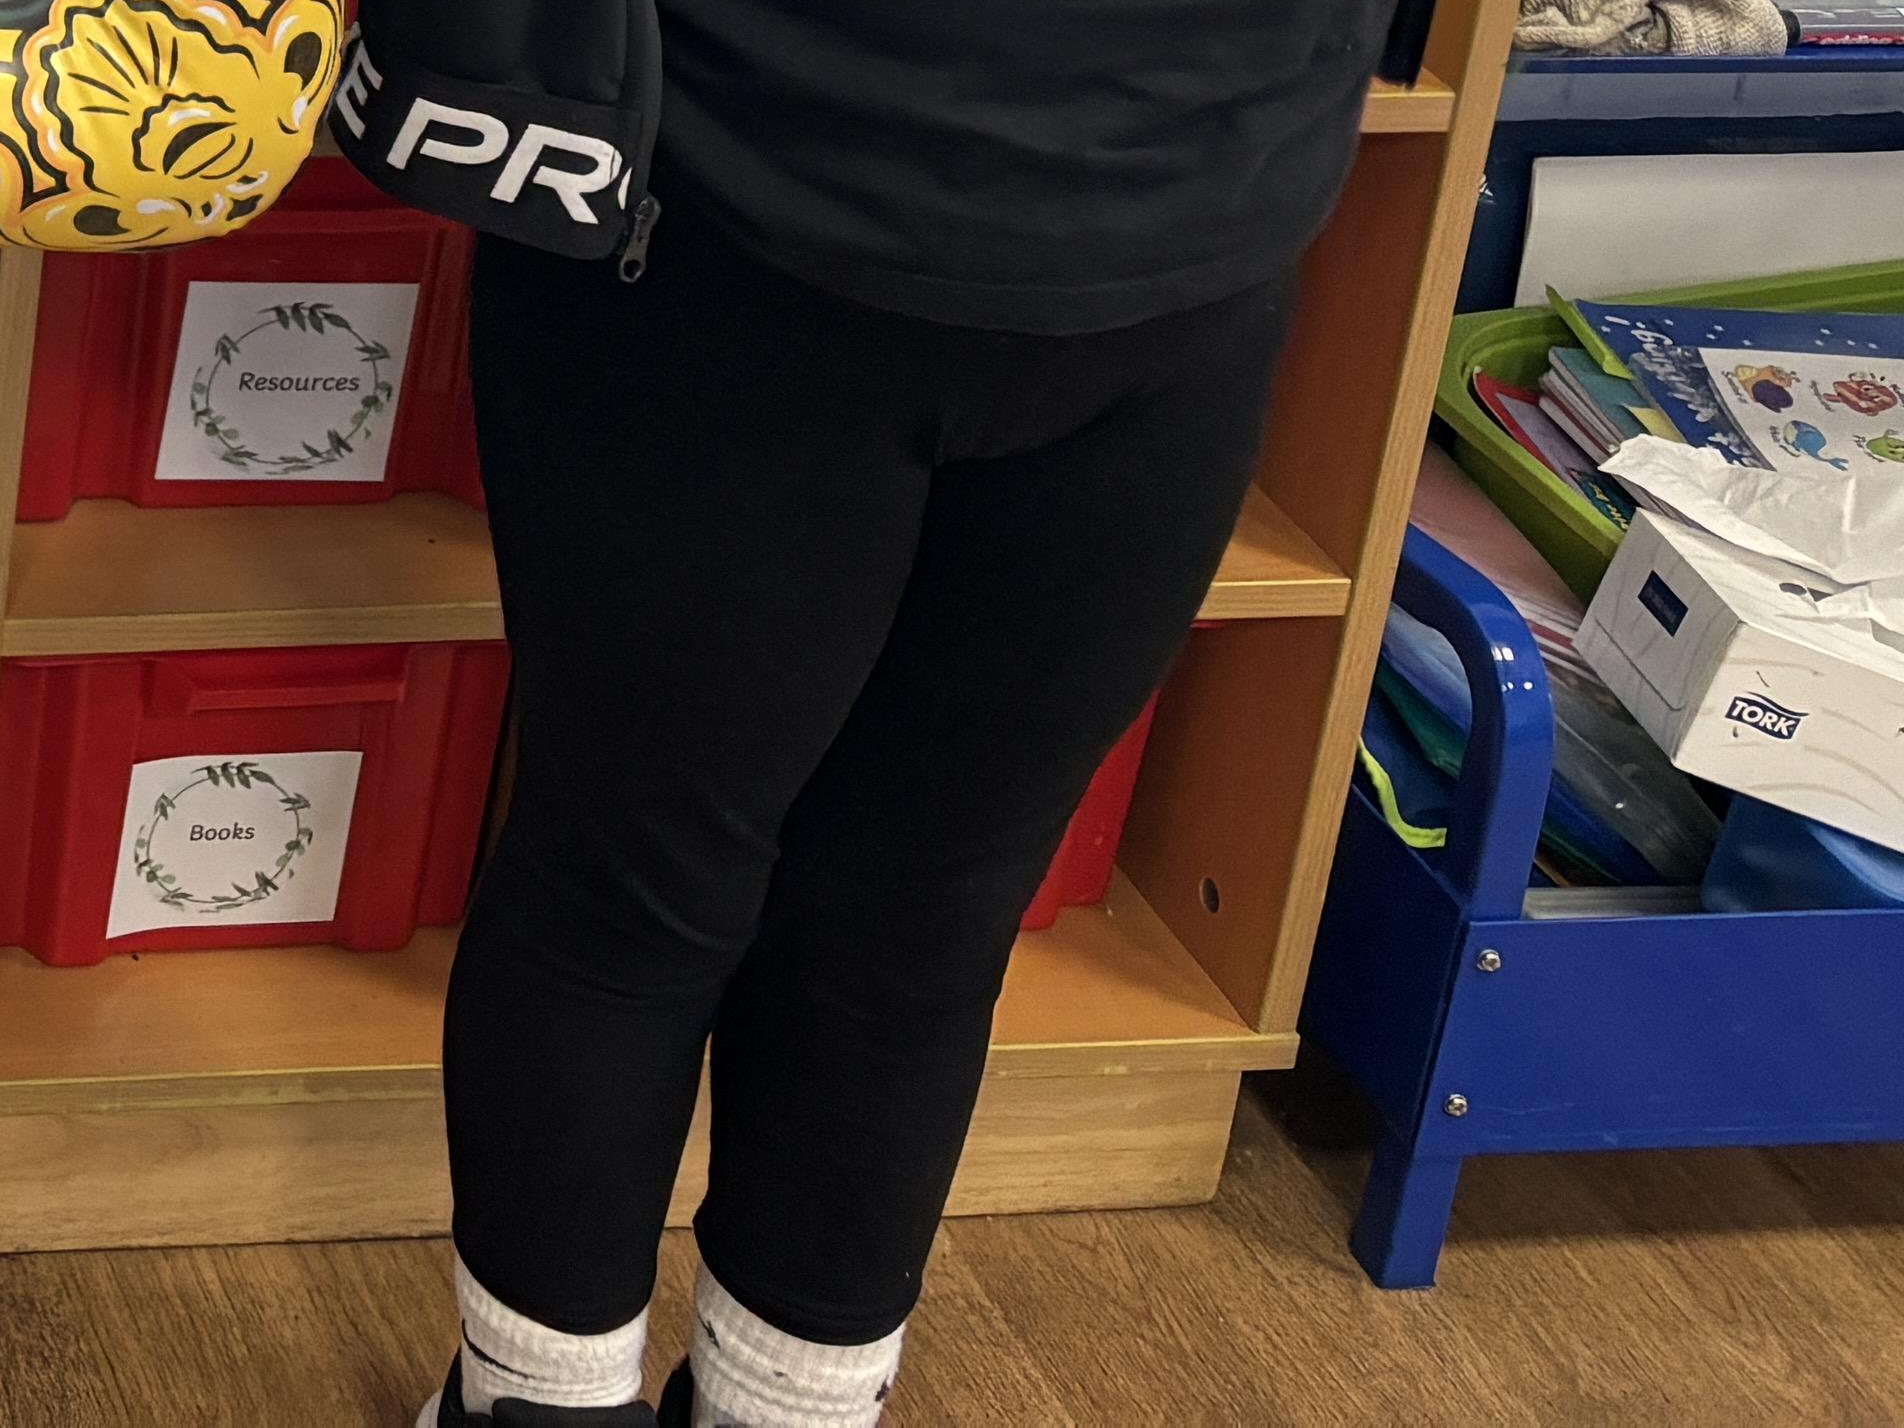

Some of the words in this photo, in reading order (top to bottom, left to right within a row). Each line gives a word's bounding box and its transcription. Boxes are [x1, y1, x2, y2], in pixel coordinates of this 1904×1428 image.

[386, 96, 633, 225] PR
[238, 372, 360, 392] Resources
[1732, 699, 1797, 737] TORK
[190, 822, 255, 841] Books
